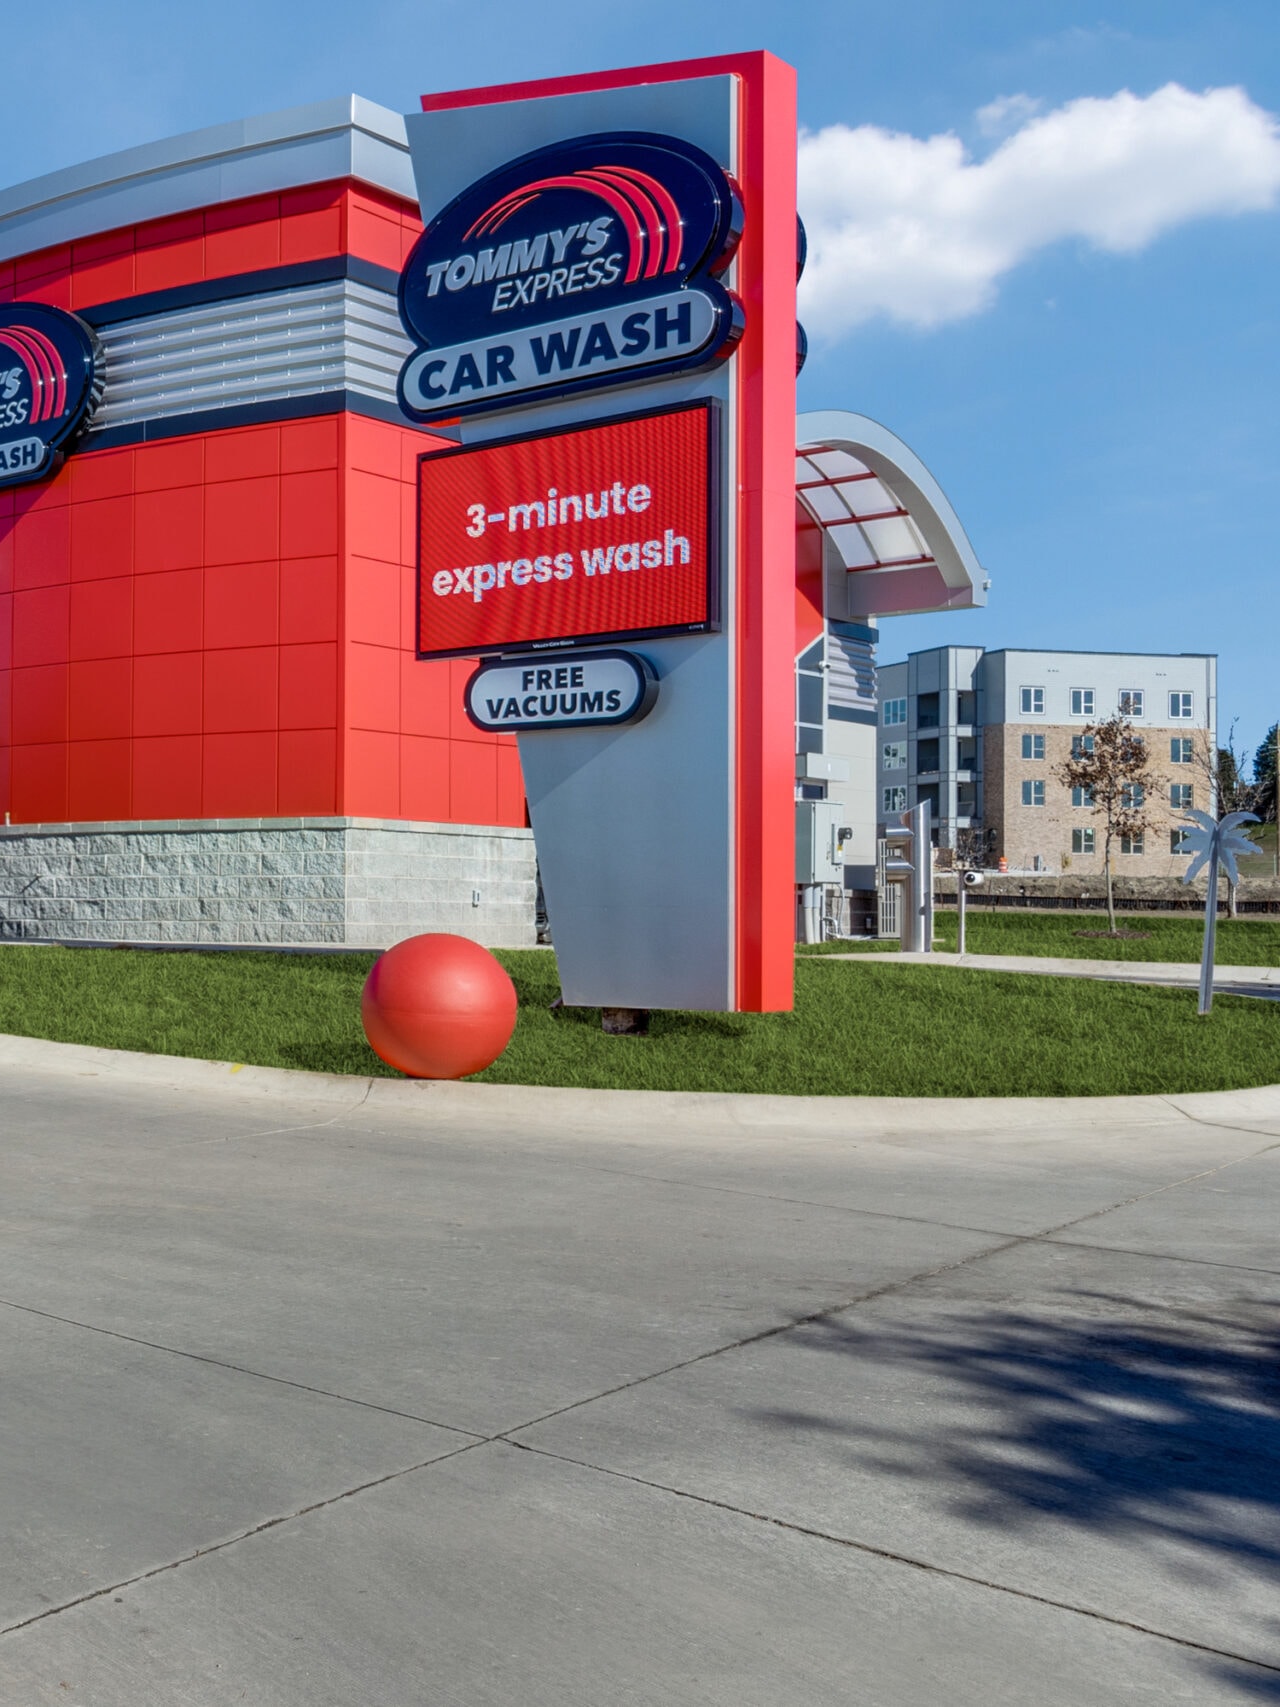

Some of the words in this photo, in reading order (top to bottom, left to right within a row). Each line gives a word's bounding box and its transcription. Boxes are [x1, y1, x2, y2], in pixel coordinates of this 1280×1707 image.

[426, 216, 614, 297] TOMMY'S
[491, 253, 623, 314] EXPRESS
[419, 345, 517, 399] CAR
[529, 301, 692, 375] WASH
[465, 481, 651, 538] 3-minute
[432, 552, 573, 602] express
[580, 529, 690, 577] wash
[486, 689, 621, 719] VACUUMS
[521, 666, 584, 692] FREE
